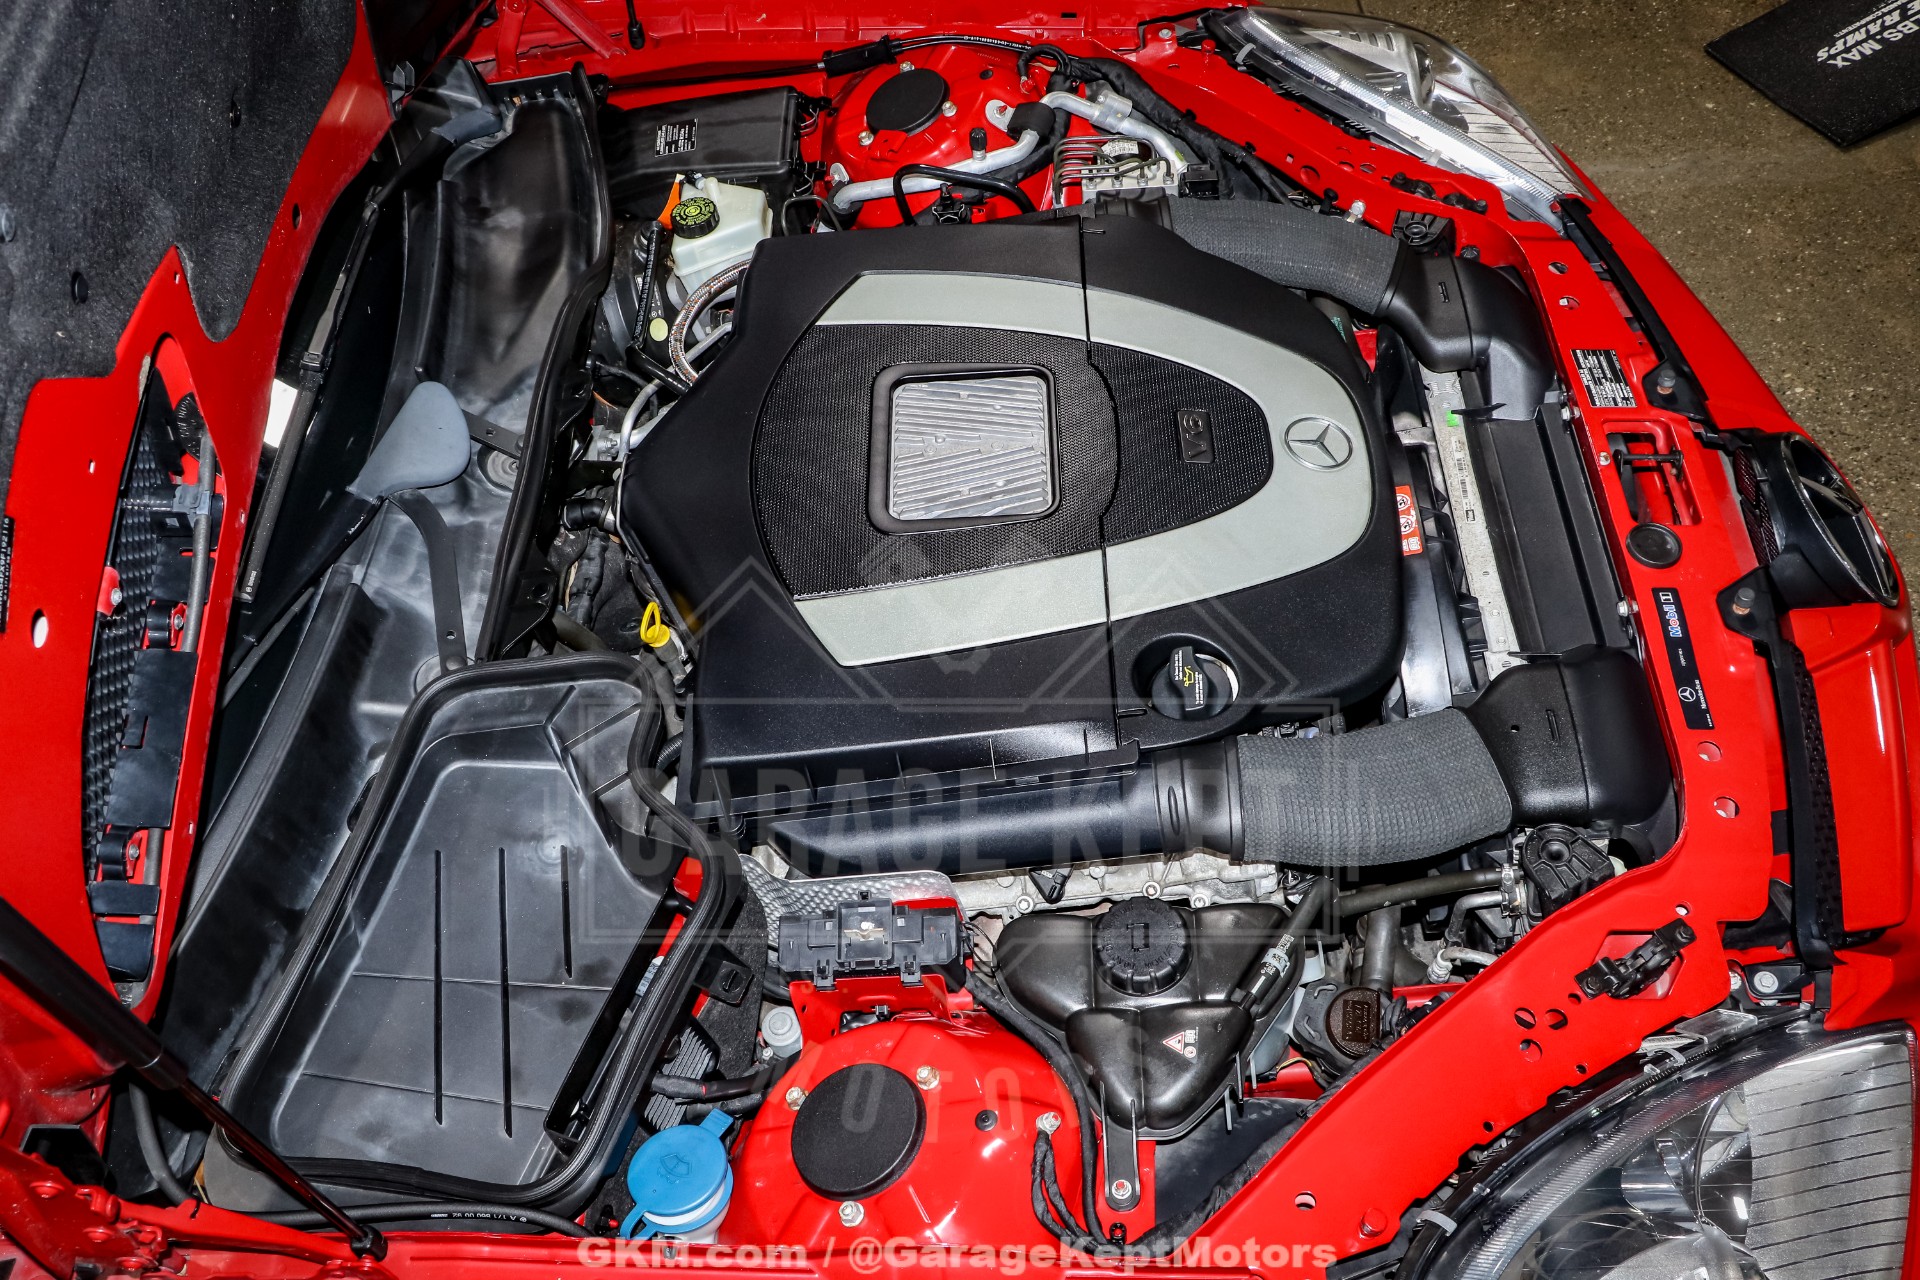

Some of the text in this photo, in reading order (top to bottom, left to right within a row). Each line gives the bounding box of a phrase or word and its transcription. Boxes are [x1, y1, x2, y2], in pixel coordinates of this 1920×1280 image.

[1816, 9, 1901, 62] RAMPS
[1826, 39, 1882, 68] MAX
[1183, 414, 1206, 458] V6
[1659, 592, 1683, 637] Mobil 1
